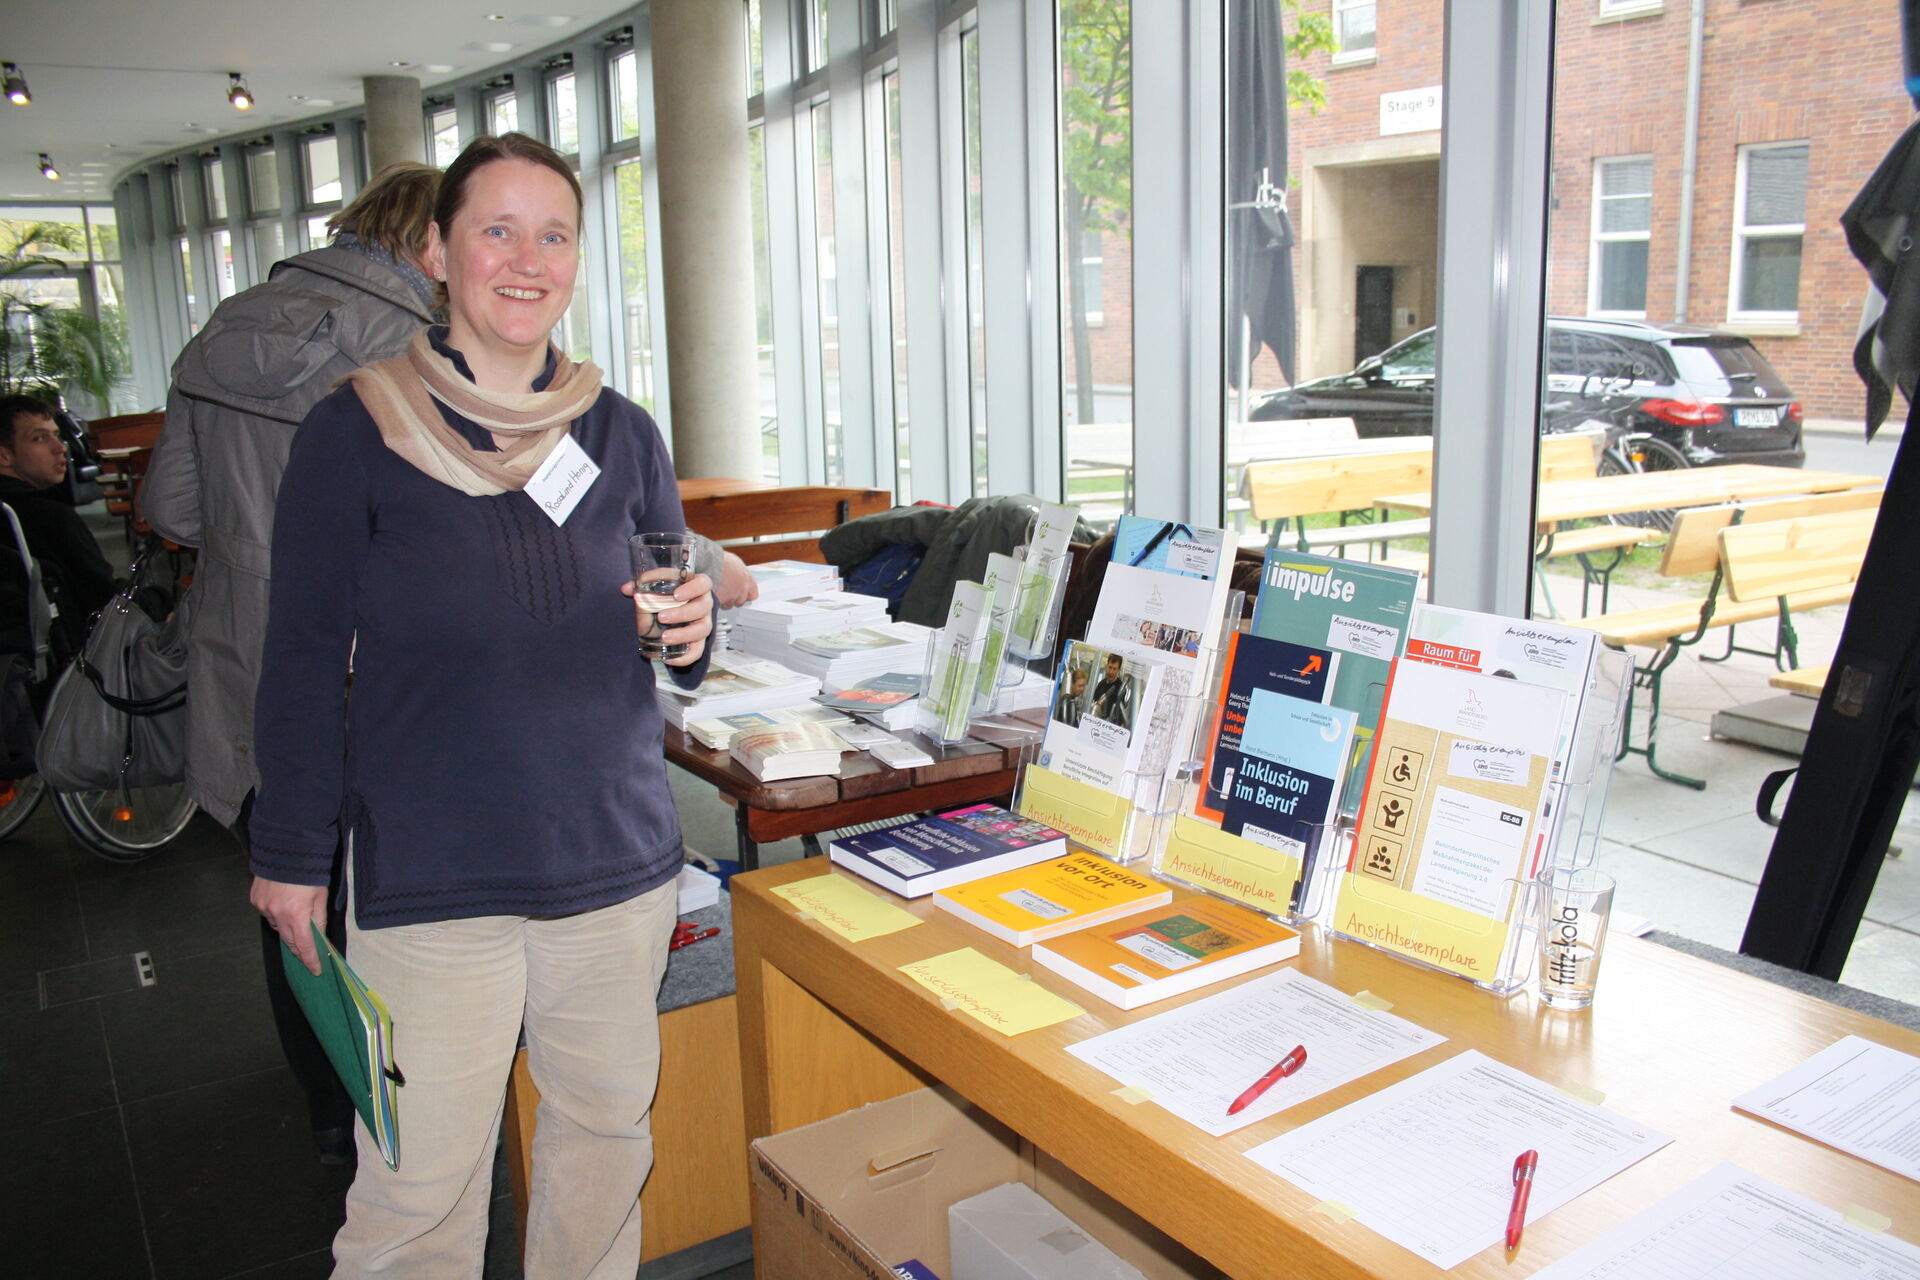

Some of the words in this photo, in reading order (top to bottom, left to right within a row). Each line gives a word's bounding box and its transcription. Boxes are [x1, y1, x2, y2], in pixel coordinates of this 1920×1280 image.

[1387, 99, 1423, 114] Stage
[1427, 96, 1435, 107] 9
[544, 479, 574, 514] Rosalind
[1269, 561, 1356, 603] impulse
[1423, 643, 1454, 660] Raum
[1457, 648, 1475, 663] für
[1240, 757, 1309, 795] Inklusion
[1235, 779, 1252, 801] im
[1256, 786, 1299, 815] Beruf
[1026, 804, 1115, 849] Ansichtsexemplare
[1056, 862, 1086, 876] vor
[1083, 873, 1115, 889] Ort
[1073, 857, 1148, 890] Inklusion
[1169, 854, 1277, 902] Ansichtsexemplare
[1346, 912, 1480, 970] Ansichtsexemplare
[1549, 906, 1578, 985] fritz-kola
